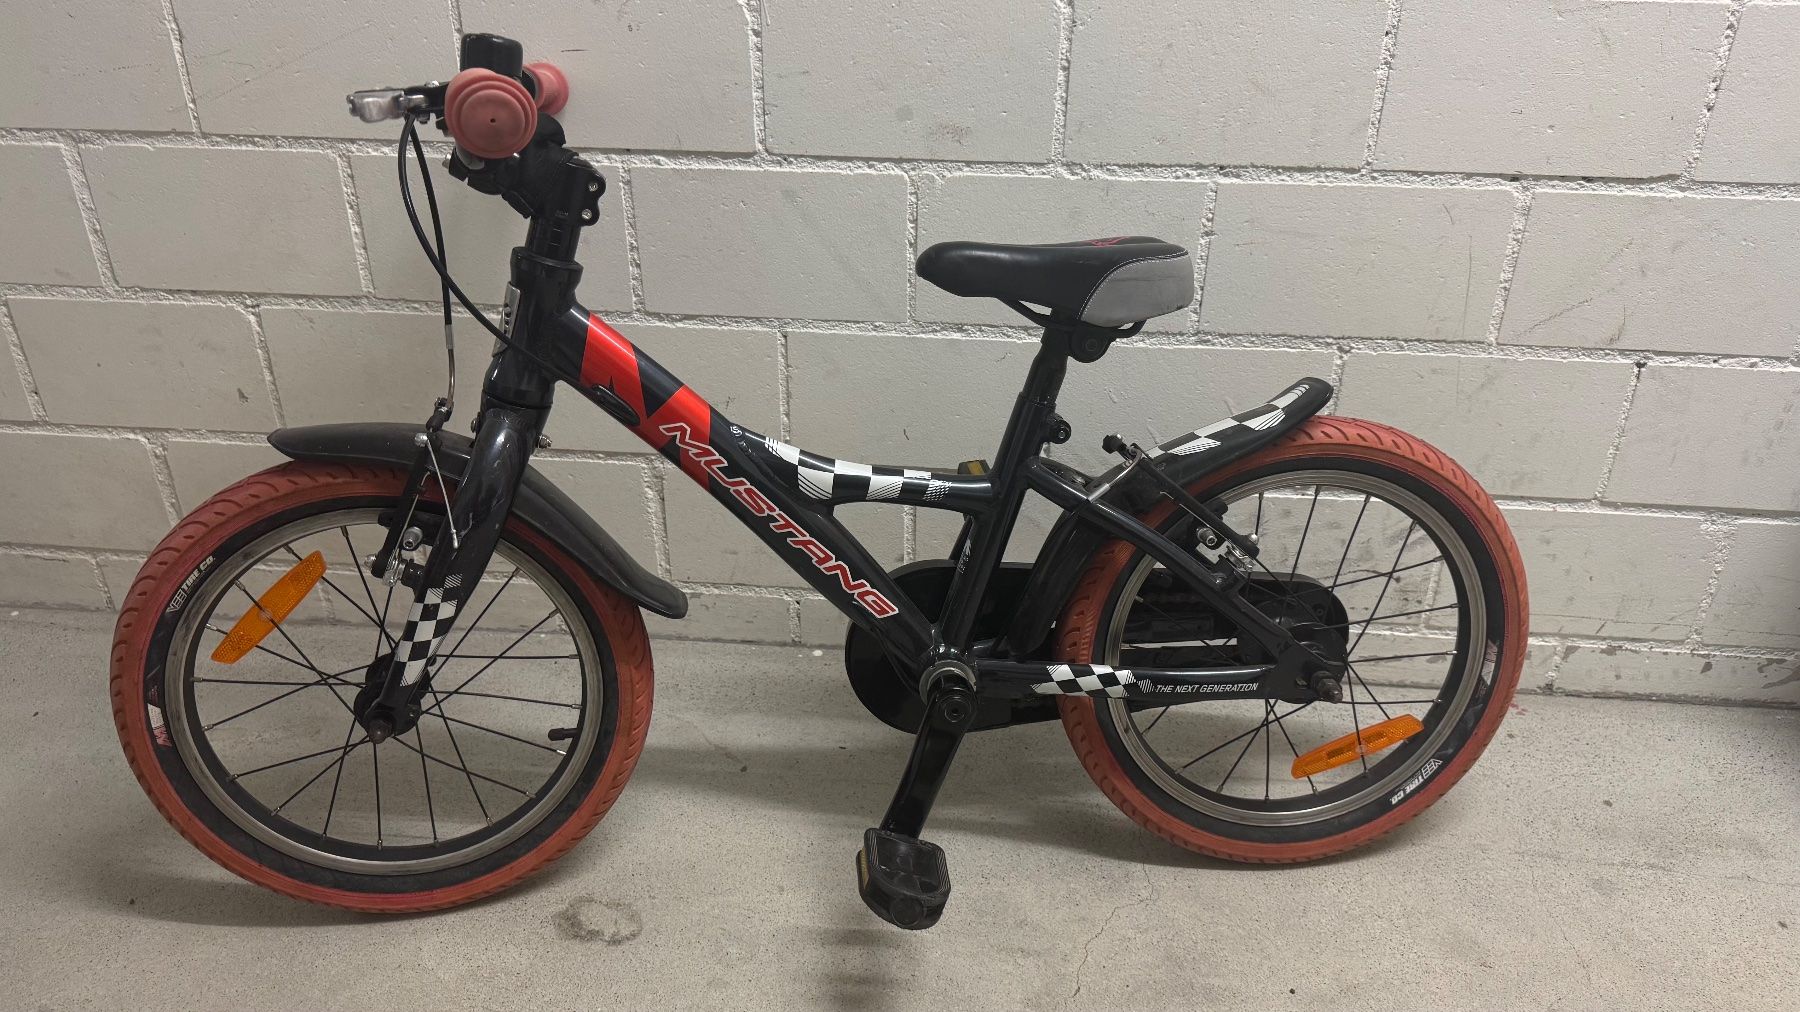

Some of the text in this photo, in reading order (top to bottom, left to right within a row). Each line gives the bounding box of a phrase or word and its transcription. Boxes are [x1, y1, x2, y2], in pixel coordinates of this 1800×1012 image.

[659, 422, 899, 618] MUSTANG
[165, 588, 188, 613] VEE
[181, 568, 200, 592] TIRE
[1155, 682, 1259, 693] THE NEXT GENERATION
[1421, 758, 1443, 779] VEE
[1404, 775, 1424, 794] TIRE
